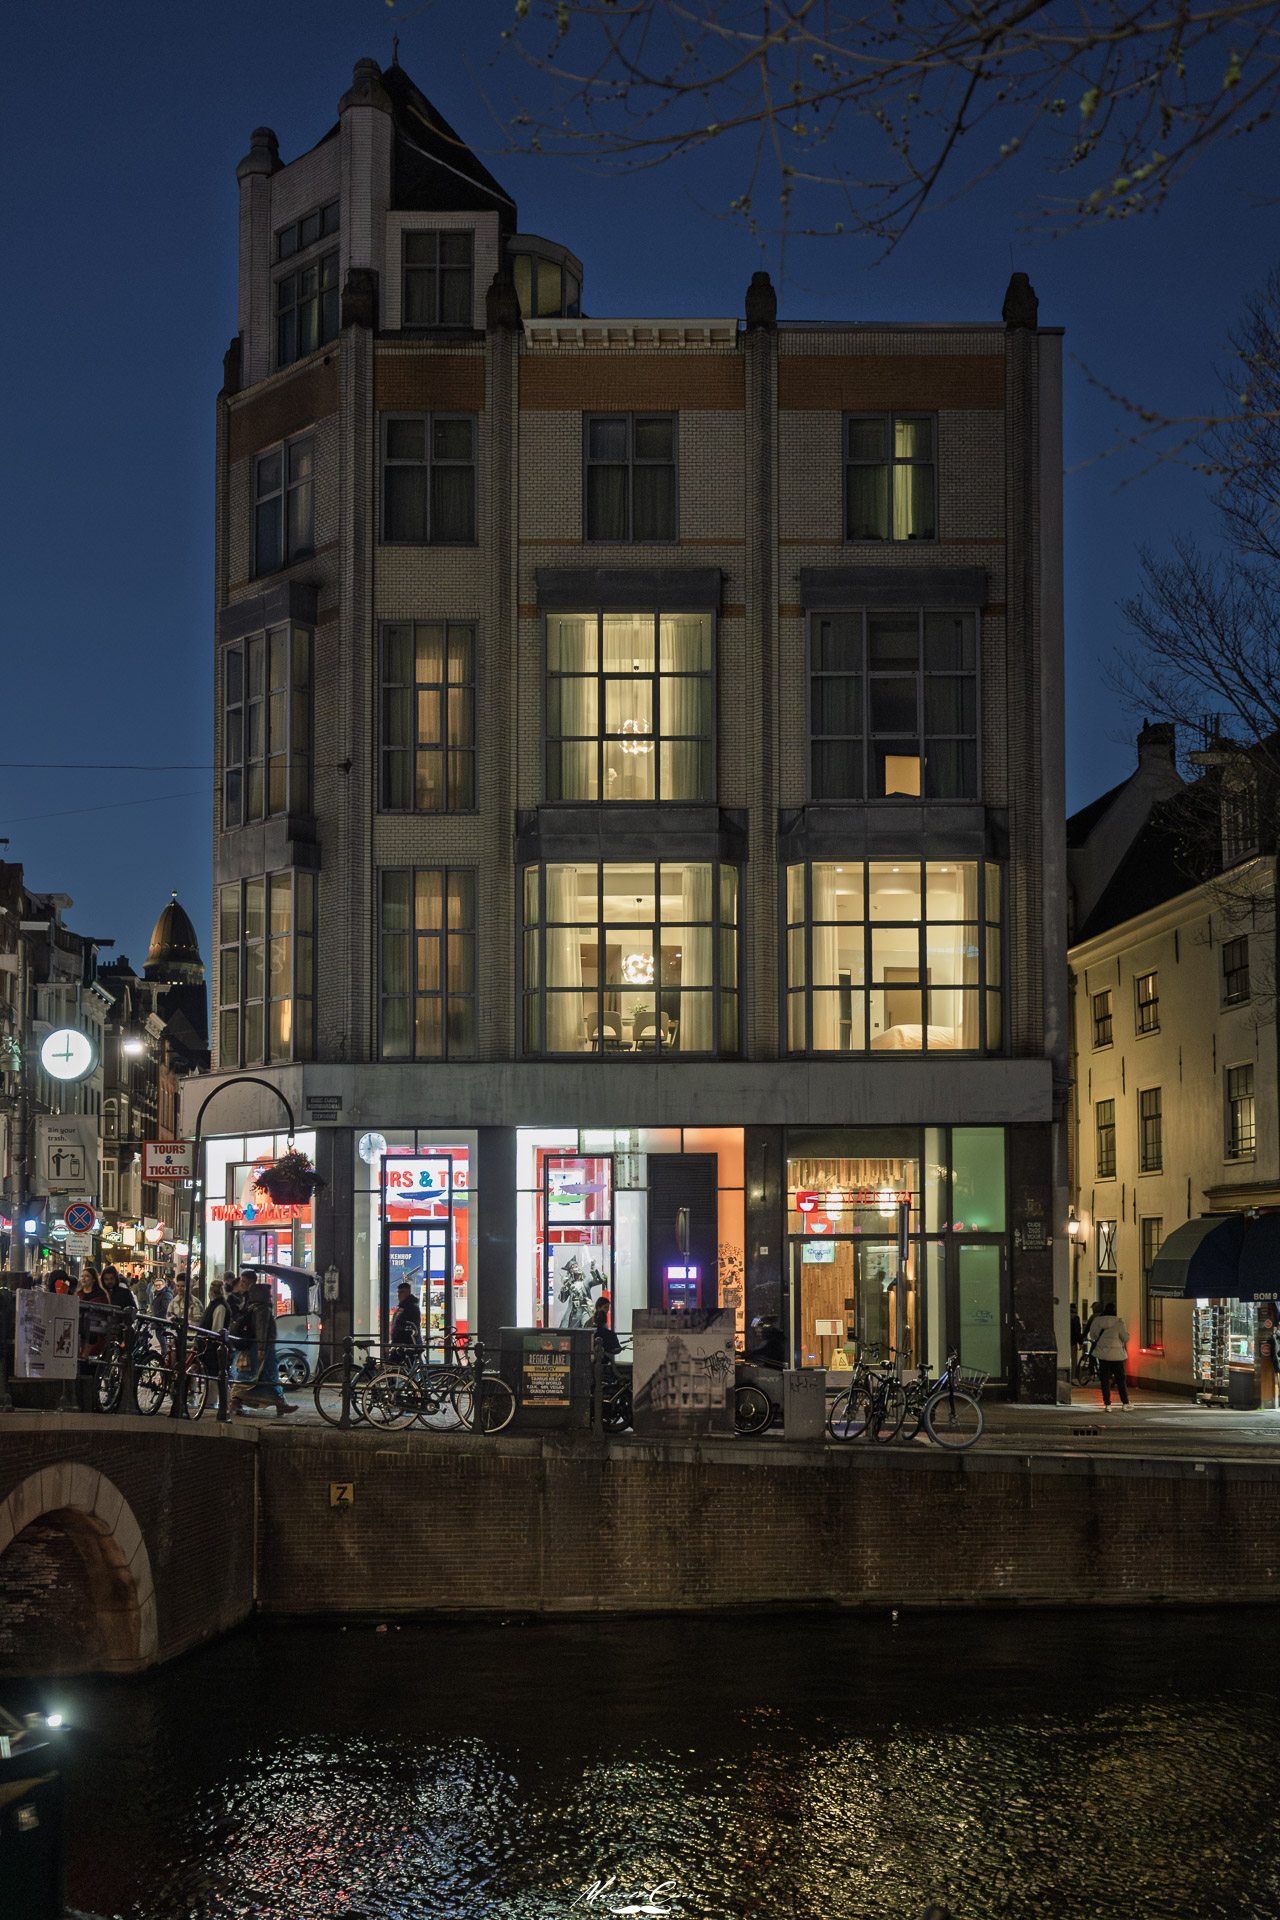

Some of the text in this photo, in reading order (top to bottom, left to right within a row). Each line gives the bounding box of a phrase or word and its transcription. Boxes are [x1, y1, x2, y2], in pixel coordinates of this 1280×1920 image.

[153, 1145, 186, 1154] TOURS
[165, 1155, 173, 1165] &
[149, 1165, 190, 1175] TICKETS
[419, 1171, 433, 1187] &
[210, 1202, 301, 1221] TOURS & TICKETS
[529, 1354, 565, 1365] REGGAE LAKE
[336, 1486, 350, 1501] Z
